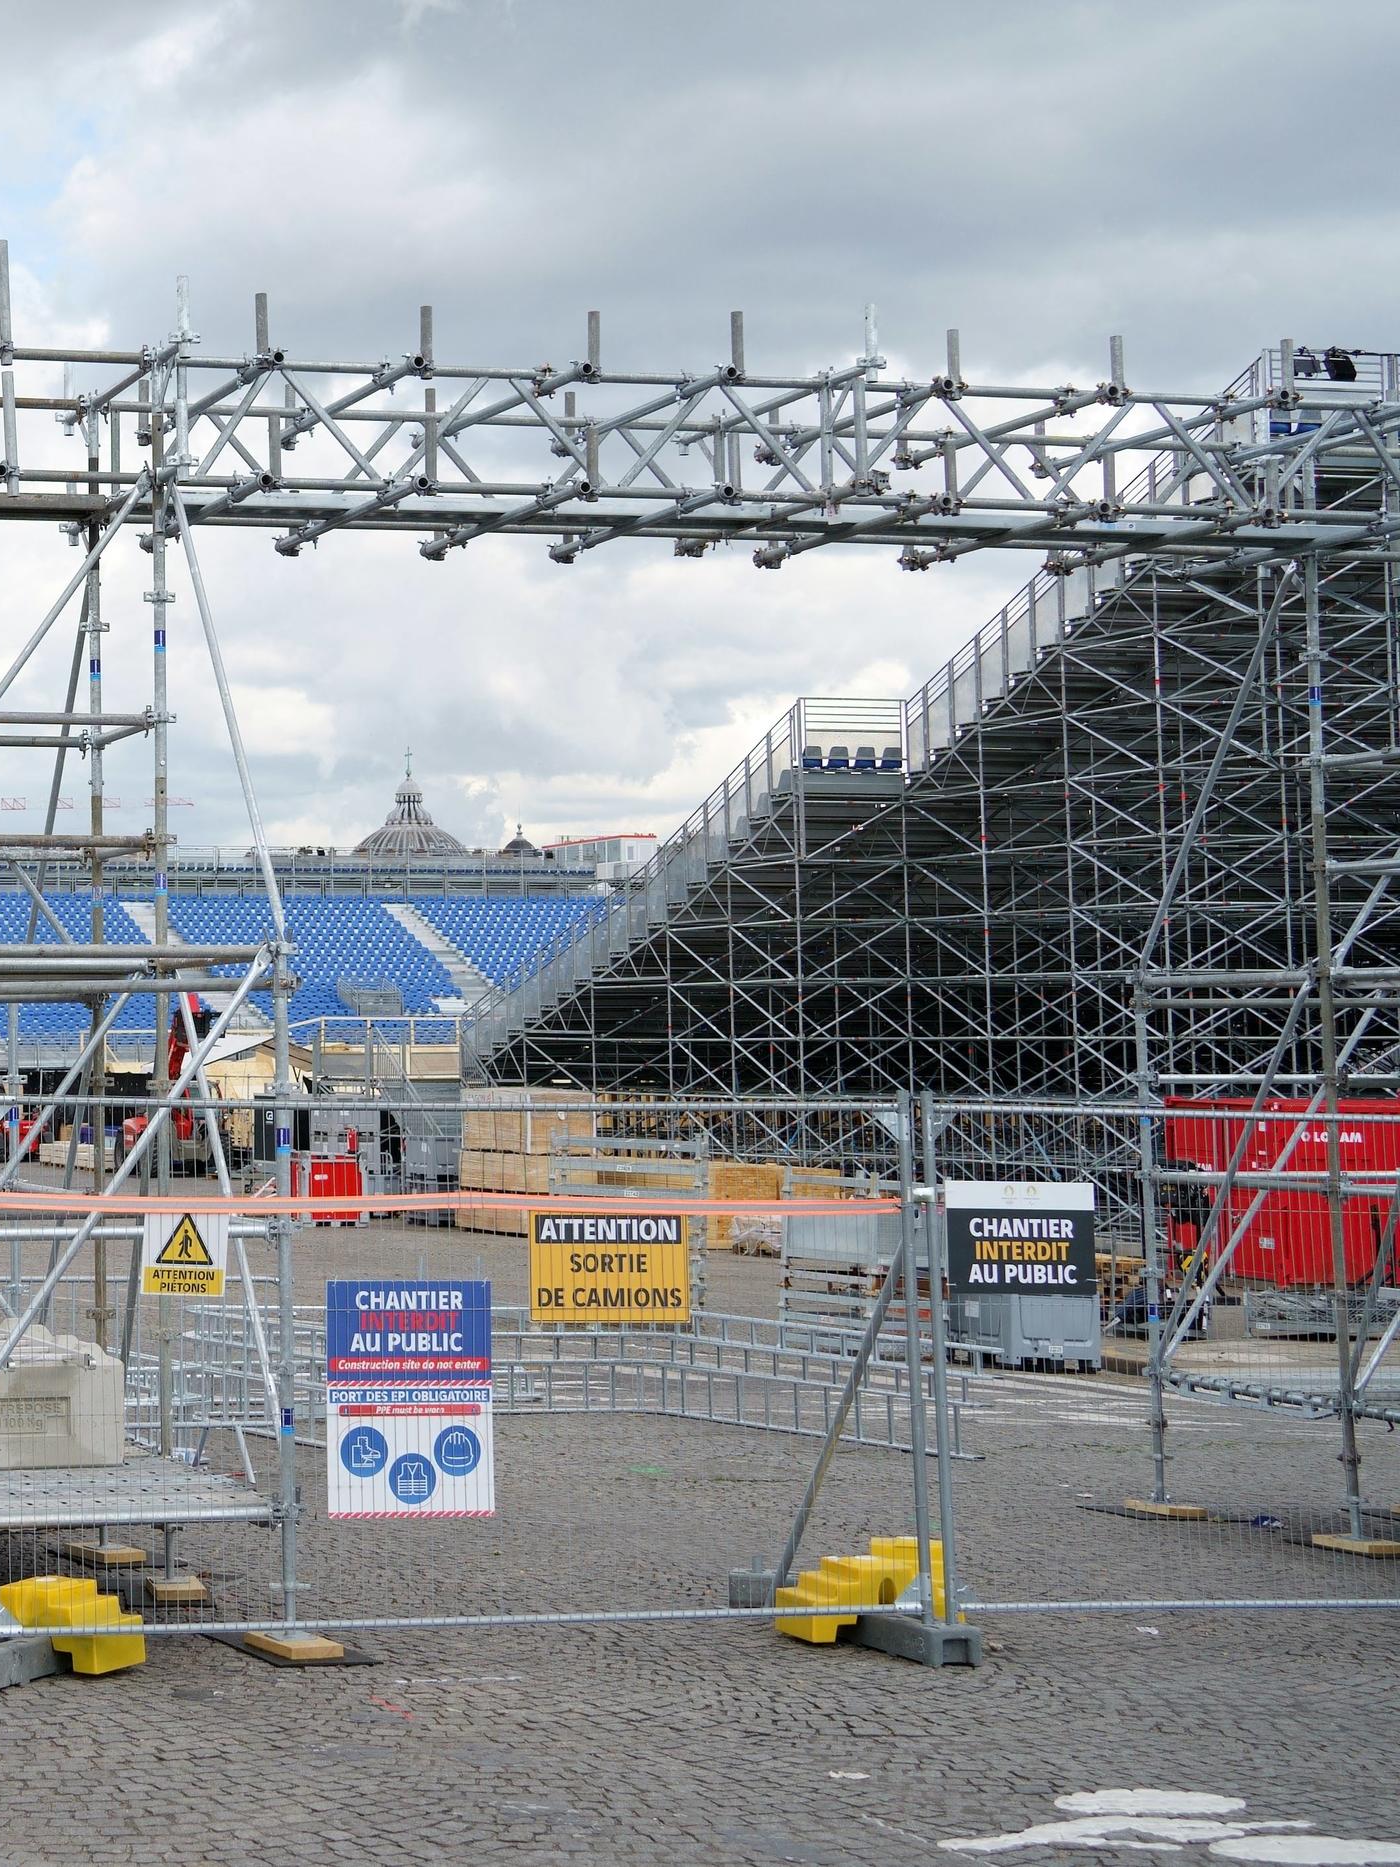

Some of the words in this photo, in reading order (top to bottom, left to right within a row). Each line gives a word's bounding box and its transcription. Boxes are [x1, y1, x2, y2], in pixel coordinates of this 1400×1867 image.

[1313, 1131, 1363, 1144] LOAM
[540, 1218, 677, 1241] ATTENTION
[969, 1217, 1074, 1239] CHANTIER
[975, 1241, 1070, 1261] INTERDIT
[570, 1253, 648, 1273] SORTIE
[152, 1269, 215, 1281] ATTENTION
[968, 1263, 998, 1284] AU
[1004, 1264, 1078, 1285] PUBLIC
[159, 1280, 207, 1293] PIÉTONS
[355, 1290, 463, 1311] CHANTIER
[537, 1287, 565, 1307] DE
[572, 1287, 682, 1308] CAMIONS
[360, 1311, 459, 1331] INTERDIT
[350, 1333, 381, 1352] AU
[388, 1333, 463, 1352] PUBLIC
[338, 1359, 400, 1370] Construction
[401, 1359, 421, 1369] site
[422, 1359, 434, 1369] do
[436, 1360, 452, 1369] not
[454, 1360, 481, 1369] enter
[331, 1391, 363, 1402] PORT
[366, 1391, 388, 1401] DES
[392, 1391, 409, 1401] EPI
[412, 1390, 488, 1401] OBLIGATOIRE
[375, 1405, 391, 1414] PPE
[392, 1406, 412, 1414] must
[413, 1405, 424, 1414] be
[425, 1406, 445, 1414] worn
